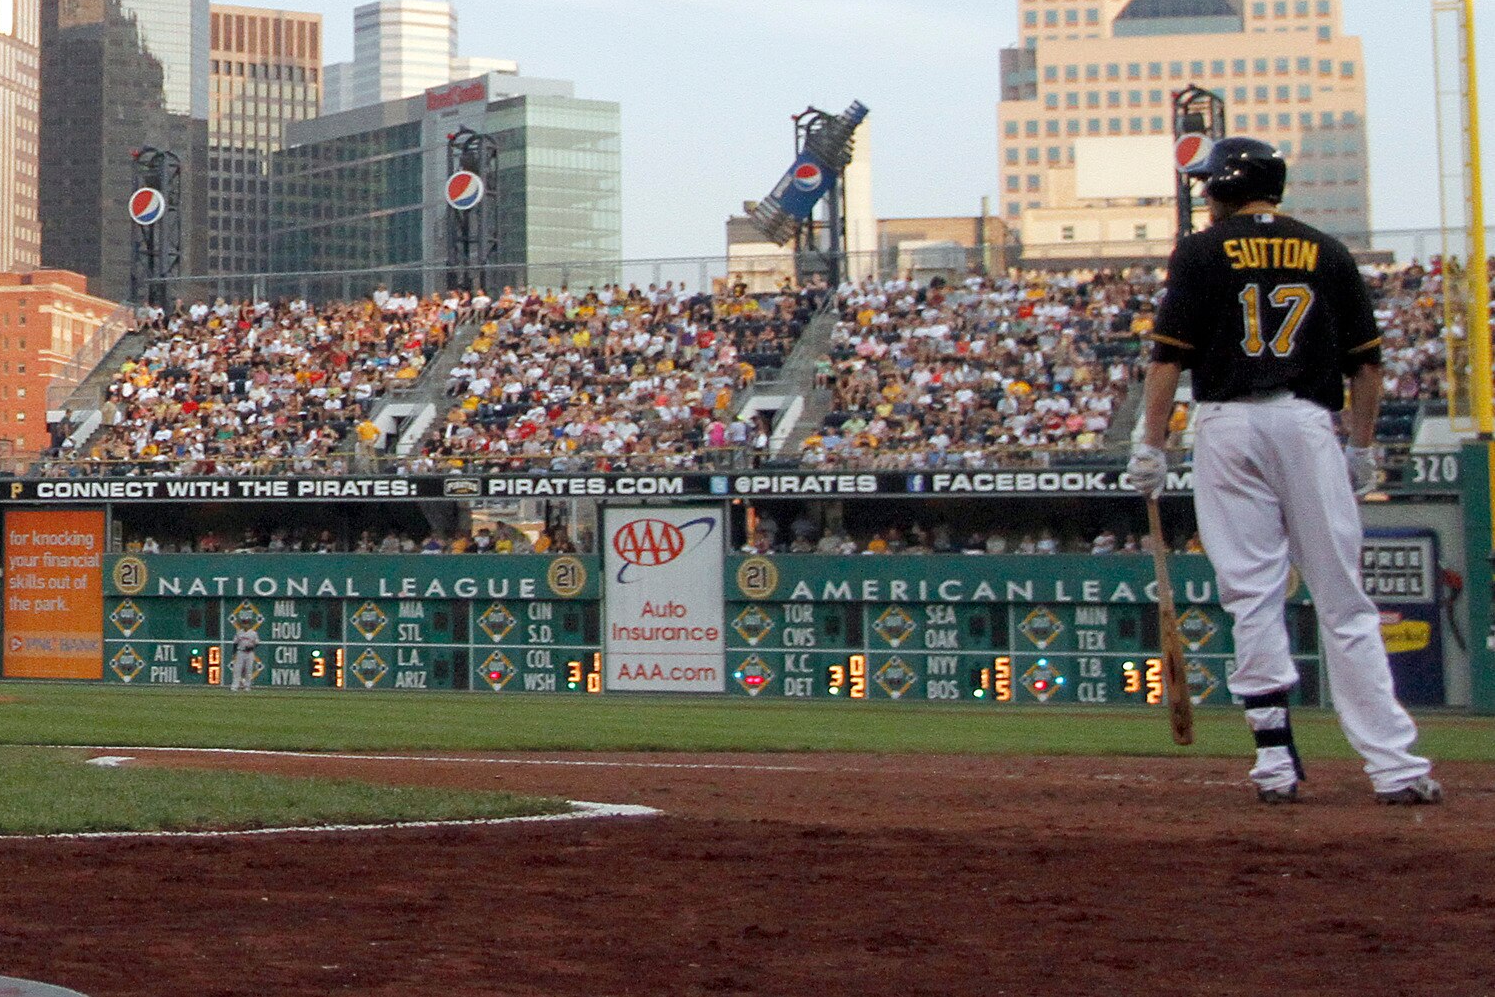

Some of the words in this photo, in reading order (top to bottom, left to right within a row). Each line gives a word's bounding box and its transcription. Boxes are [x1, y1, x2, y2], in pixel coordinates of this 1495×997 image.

[1222, 236, 1320, 272] SUTTON
[1238, 283, 1315, 358] 17
[1412, 455, 1456, 483] 320
[37, 482, 159, 498] CONNECT
[166, 481, 230, 497] WITH
[238, 481, 289, 497] THE
[297, 480, 418, 496] PIRATES:
[488, 477, 683, 495] PIRATES.COM
[734, 475, 878, 493] @PIRATES
[932, 472, 1193, 492] FACEBOOK.CM
[9, 530, 29, 545] for
[33, 530, 93, 549] knocking
[620, 520, 678, 565] AAA
[9, 555, 39, 570] your
[43, 551, 100, 567] financial
[9, 574, 45, 589] skills
[48, 576, 71, 589] out
[74, 574, 88, 589] of
[121, 565, 138, 586] 21
[158, 577, 359, 596] NATIONAL
[379, 578, 536, 597] LEAGUE
[556, 565, 576, 586] 21
[747, 566, 767, 588] 21
[790, 580, 1034, 601] AMERICAN
[1365, 577, 1420, 592] FUEL
[9, 597, 30, 611] the
[274, 601, 298, 617] MIL
[399, 601, 424, 618] MIA
[528, 603, 552, 620] CIN
[641, 600, 687, 618] Auto
[783, 604, 813, 623] TOR
[925, 606, 956, 624] SEA
[1075, 606, 1106, 625] MIN
[272, 622, 301, 639] HOU
[398, 624, 423, 641] STL
[612, 623, 718, 641] Insurance
[783, 628, 816, 647] CWS
[925, 630, 958, 649] OAK
[1076, 630, 1106, 649] TEX
[154, 645, 178, 662] ATL
[275, 647, 298, 664] CHI
[526, 651, 554, 668] COL
[618, 663, 716, 681] AAA.com
[927, 656, 957, 675] NYY
[150, 667, 180, 683] PHIL
[271, 668, 301, 686] NYM
[395, 671, 427, 689] ARIZ
[523, 673, 556, 691] WSH
[784, 678, 813, 696] DET
[927, 680, 959, 700] BOS
[1077, 682, 1106, 702] CLE
